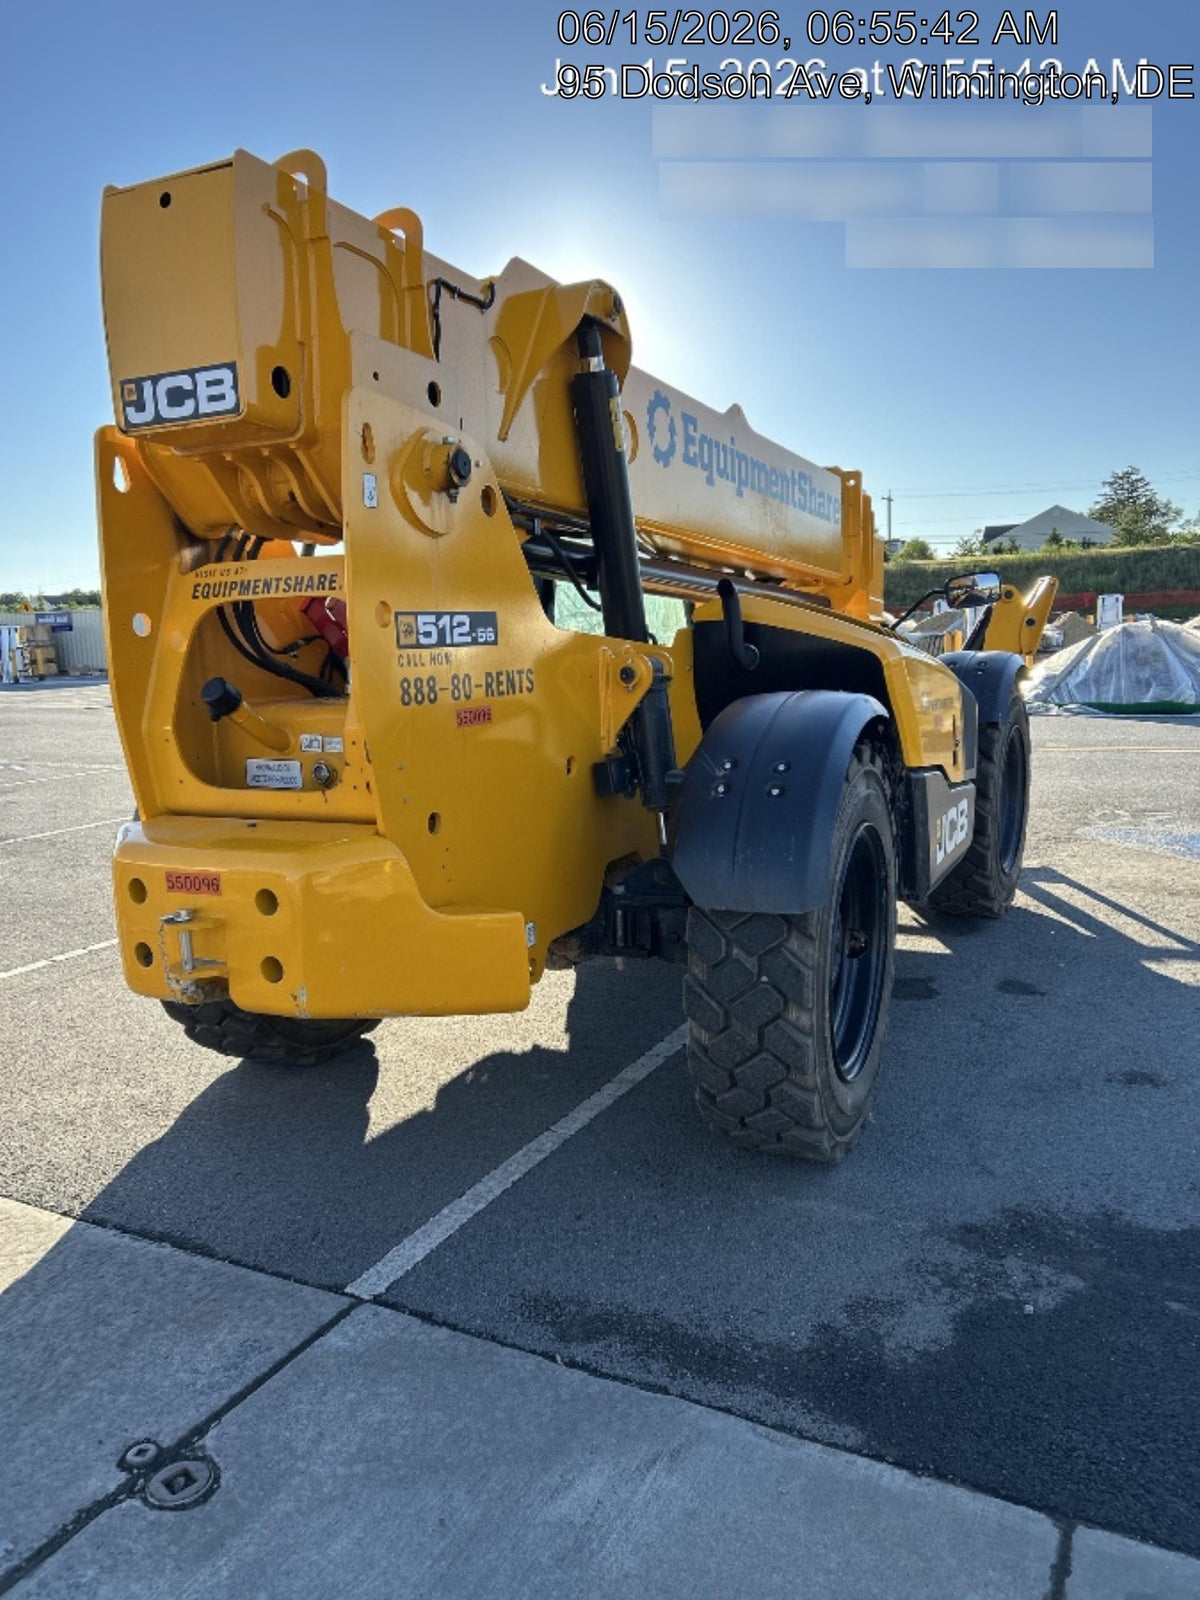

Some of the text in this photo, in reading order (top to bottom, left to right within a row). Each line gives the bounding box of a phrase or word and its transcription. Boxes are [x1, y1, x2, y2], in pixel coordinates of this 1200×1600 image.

[125, 368, 237, 423] JCB
[681, 411, 840, 525] EquipmentShare
[398, 653, 425, 667] CALL
[400, 668, 534, 706] 888-80-RENTS
[936, 798, 968, 865] JCB
[167, 875, 220, 892] 550096
